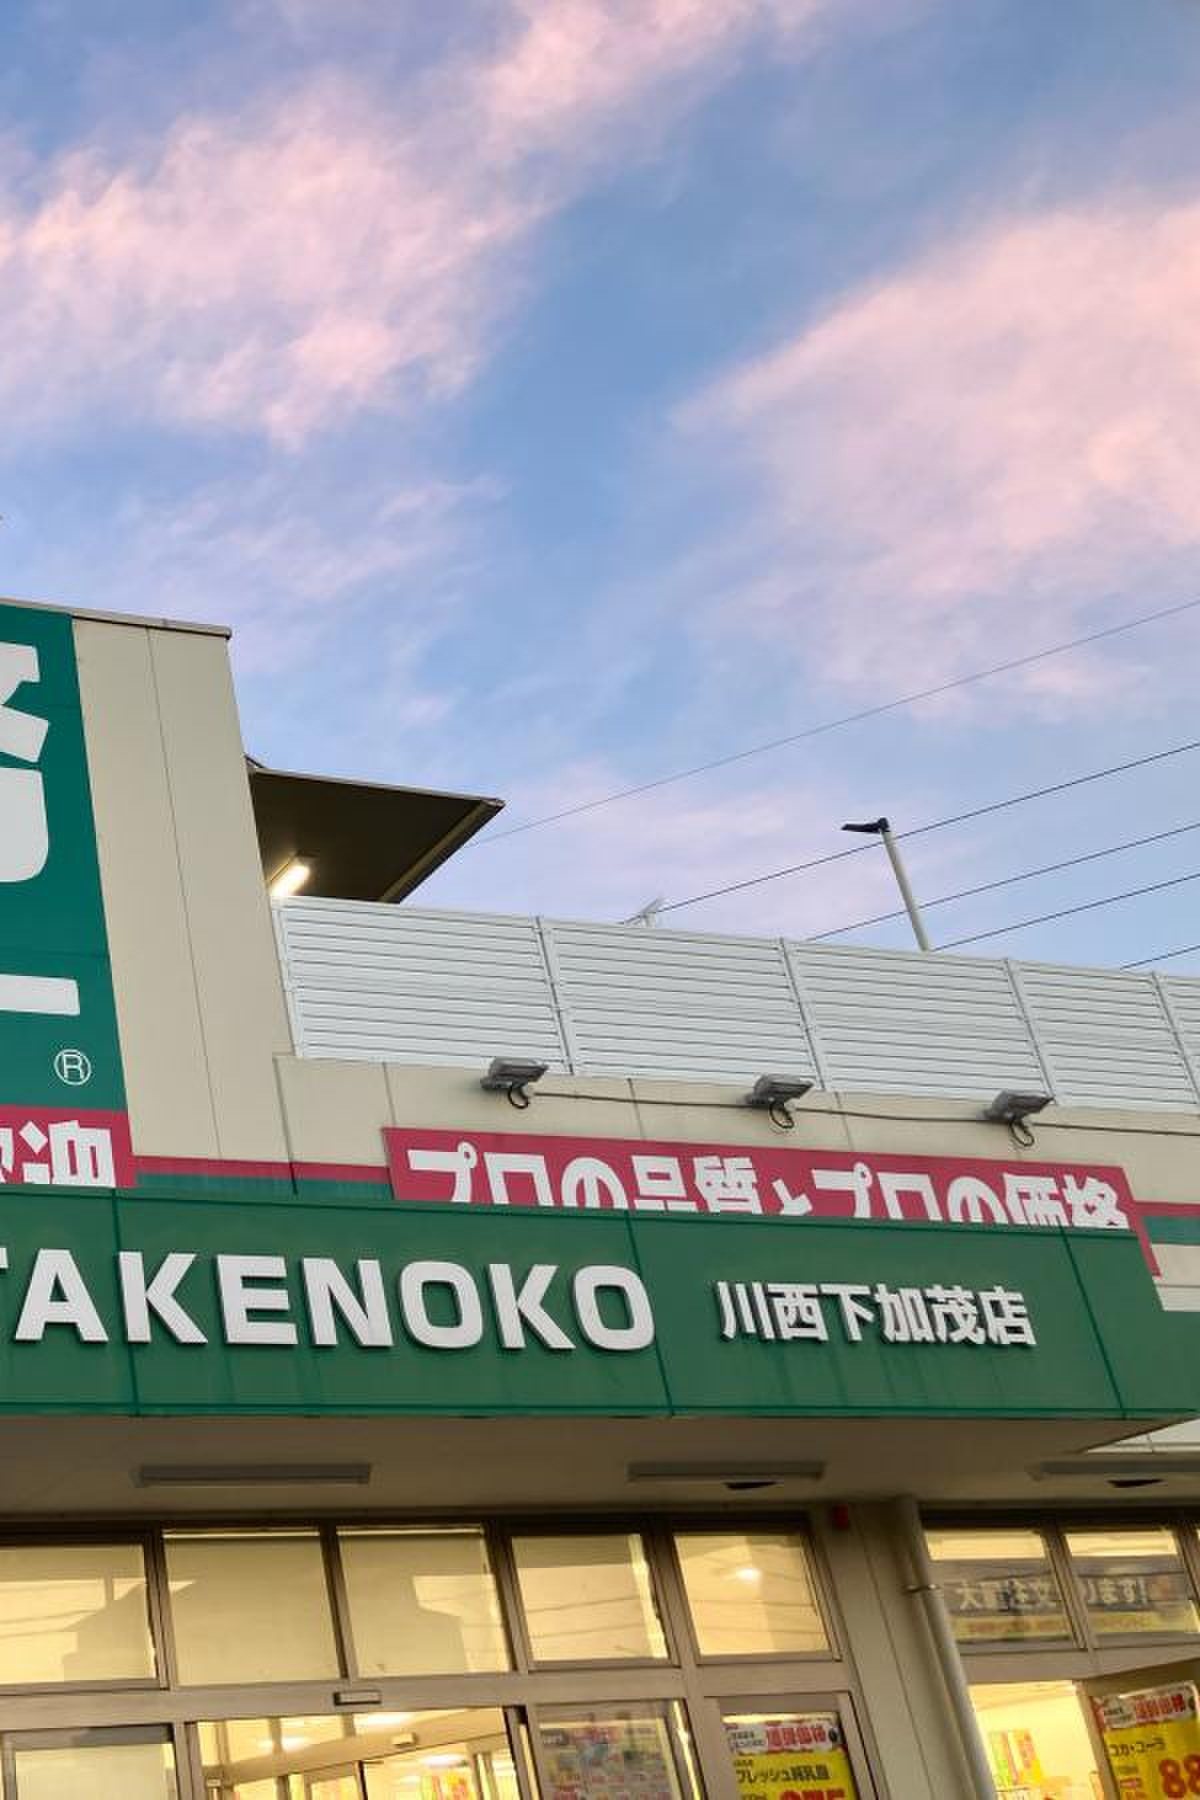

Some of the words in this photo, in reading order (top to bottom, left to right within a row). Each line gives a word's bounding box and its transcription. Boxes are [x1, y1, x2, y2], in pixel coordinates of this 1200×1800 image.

[715, 1280, 1038, 1346] 川西下加茂店
